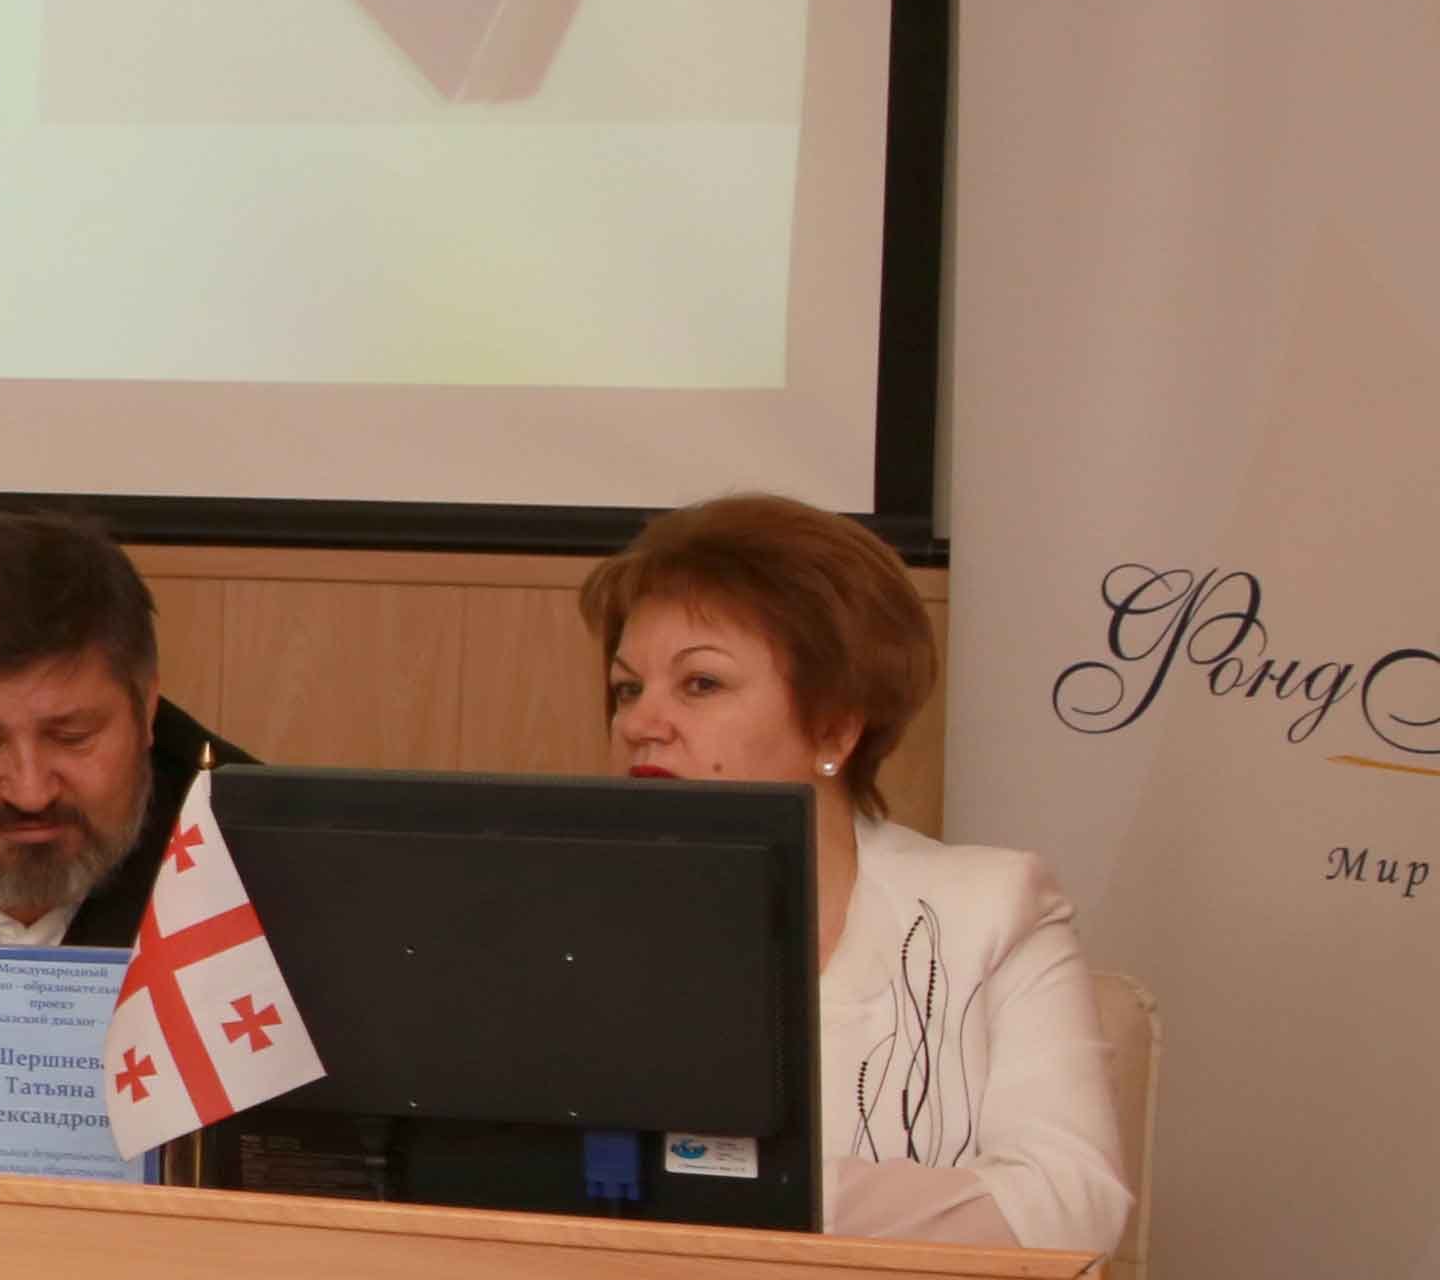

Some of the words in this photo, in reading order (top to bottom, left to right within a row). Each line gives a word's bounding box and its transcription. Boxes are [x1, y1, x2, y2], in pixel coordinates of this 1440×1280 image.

[1051, 562, 1358, 745] Фонд
[1325, 846, 1431, 898] Мир
[4, 1075, 97, 1099] Татьяна
